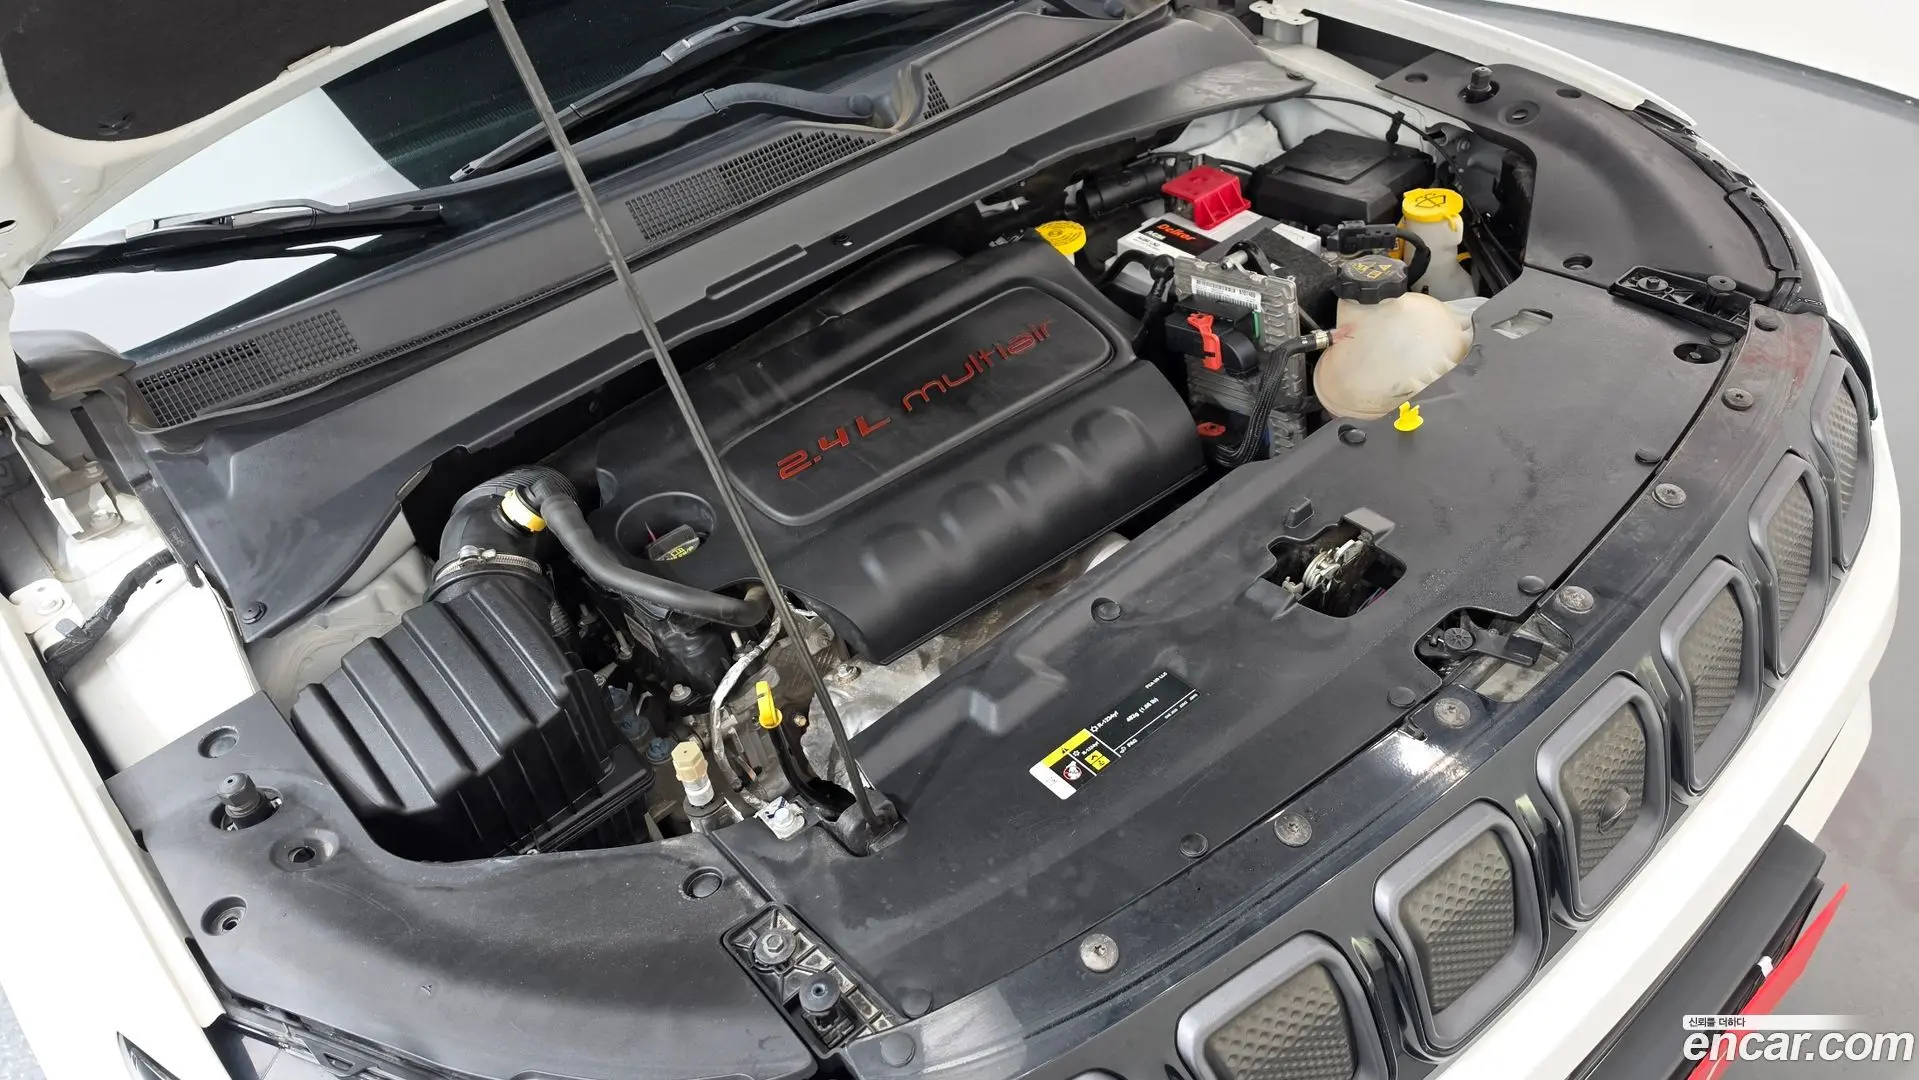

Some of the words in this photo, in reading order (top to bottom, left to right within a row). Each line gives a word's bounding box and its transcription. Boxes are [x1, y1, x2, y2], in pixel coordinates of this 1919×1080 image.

[1156, 223, 1197, 241] Delkor
[776, 426, 850, 481] 2.4
[902, 318, 1056, 413] multiair
